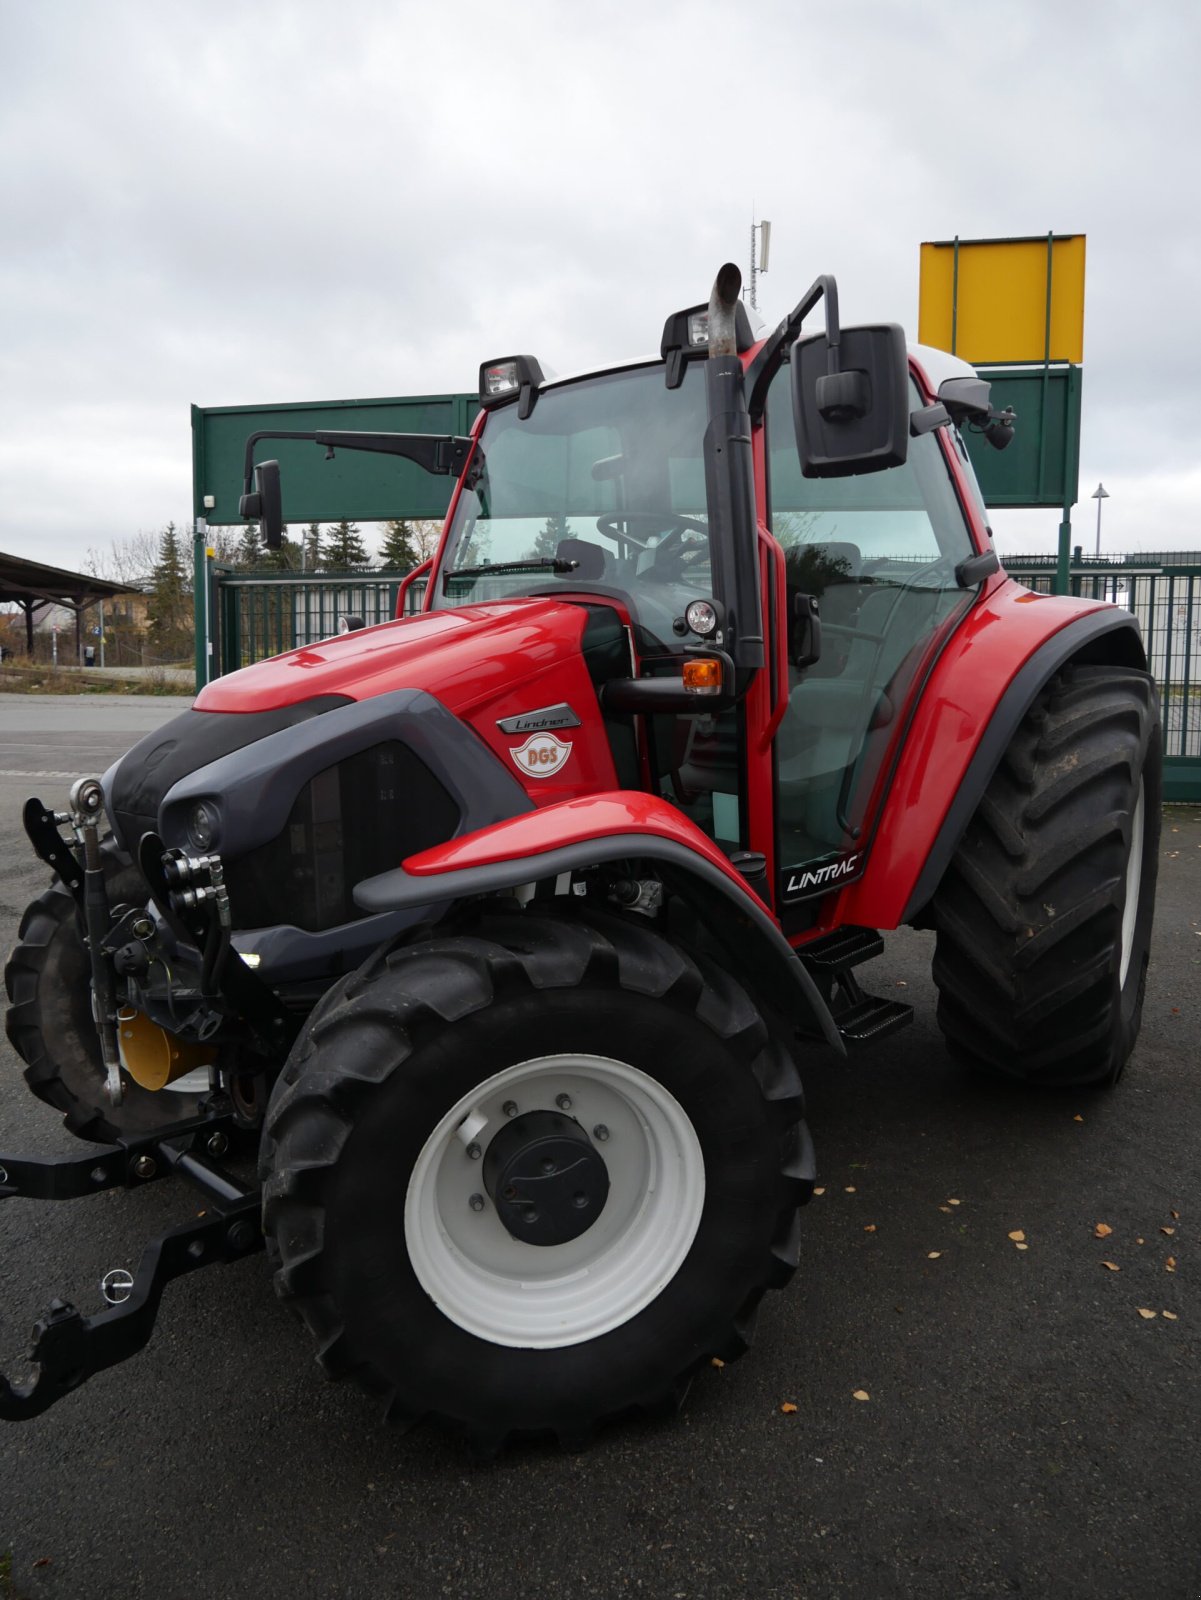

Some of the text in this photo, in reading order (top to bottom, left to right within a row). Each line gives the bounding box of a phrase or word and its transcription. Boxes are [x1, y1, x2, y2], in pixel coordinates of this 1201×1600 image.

[515, 718, 569, 730] Lindner
[528, 745, 558, 767] DGS
[786, 855, 858, 892] LINTRAC
